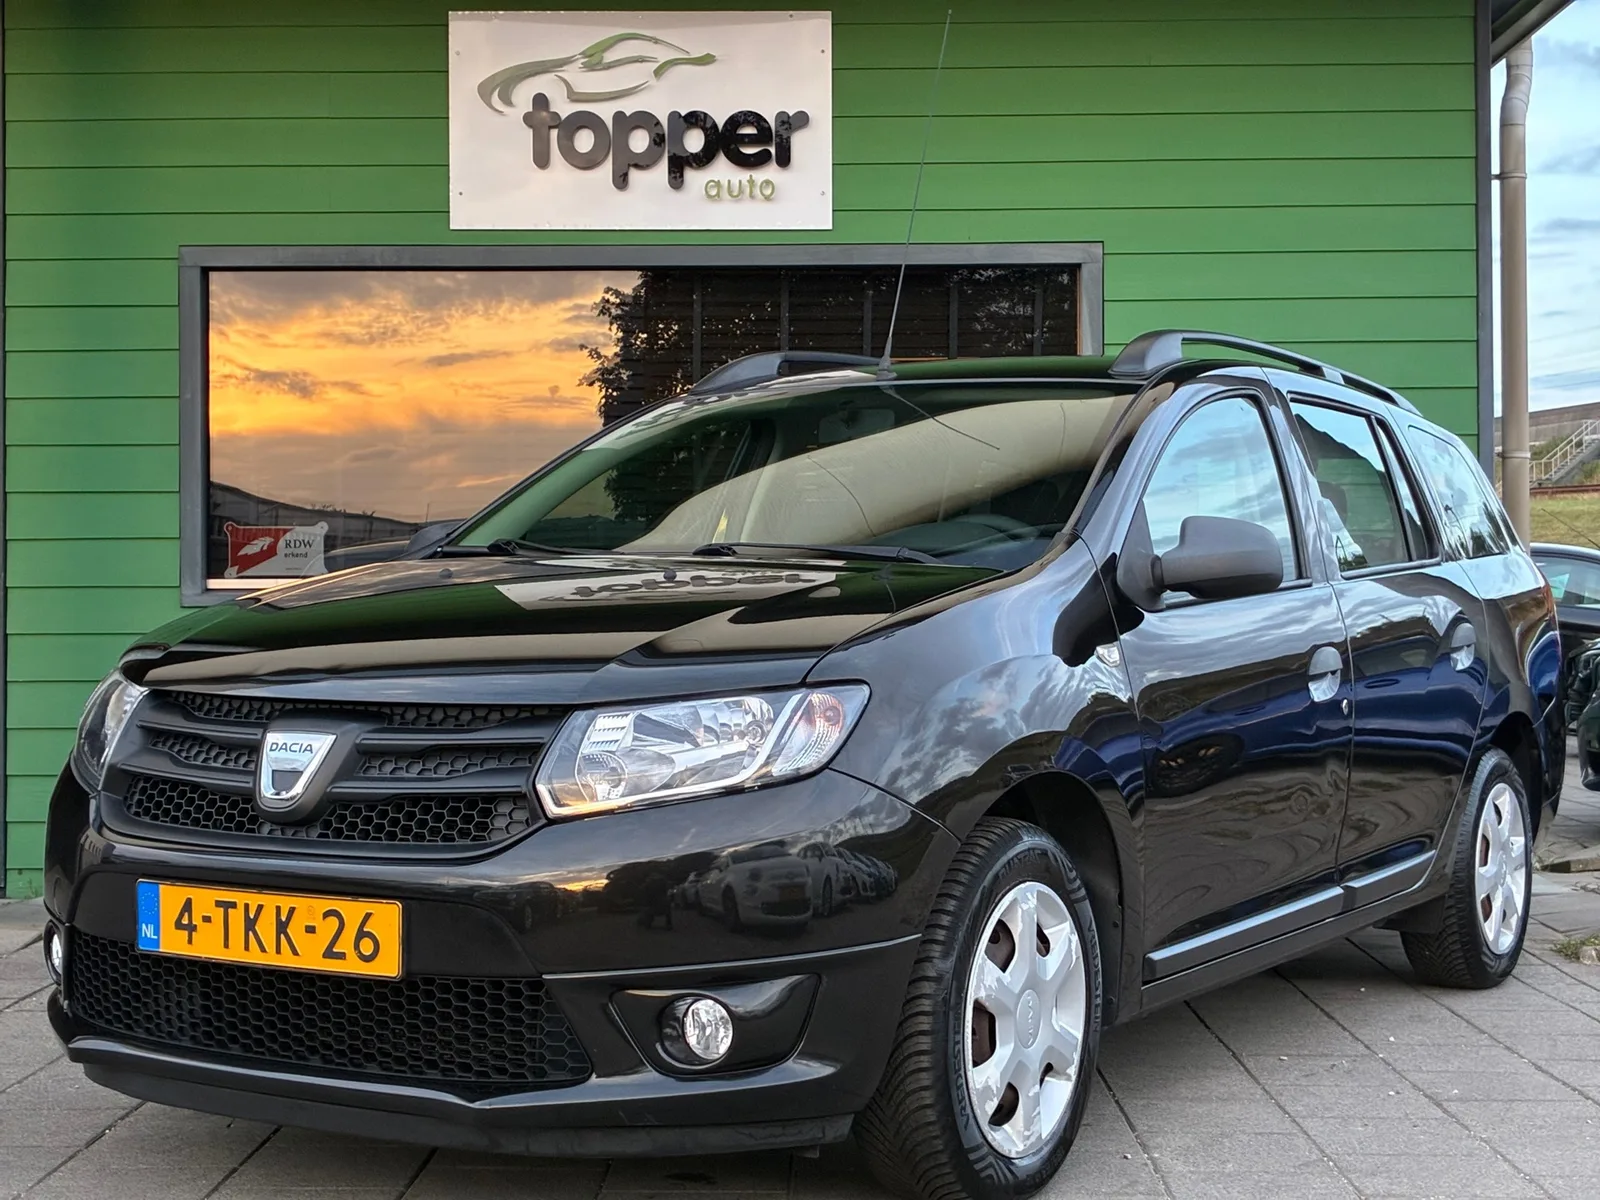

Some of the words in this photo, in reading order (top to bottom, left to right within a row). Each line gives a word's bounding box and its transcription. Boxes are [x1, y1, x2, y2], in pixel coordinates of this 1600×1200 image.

[522, 92, 810, 191] topper
[704, 174, 776, 200] auto
[284, 539, 315, 549] RDW
[268, 742, 314, 754] DACIA
[141, 923, 158, 939] NL
[174, 897, 381, 963] 4-TKK-26
